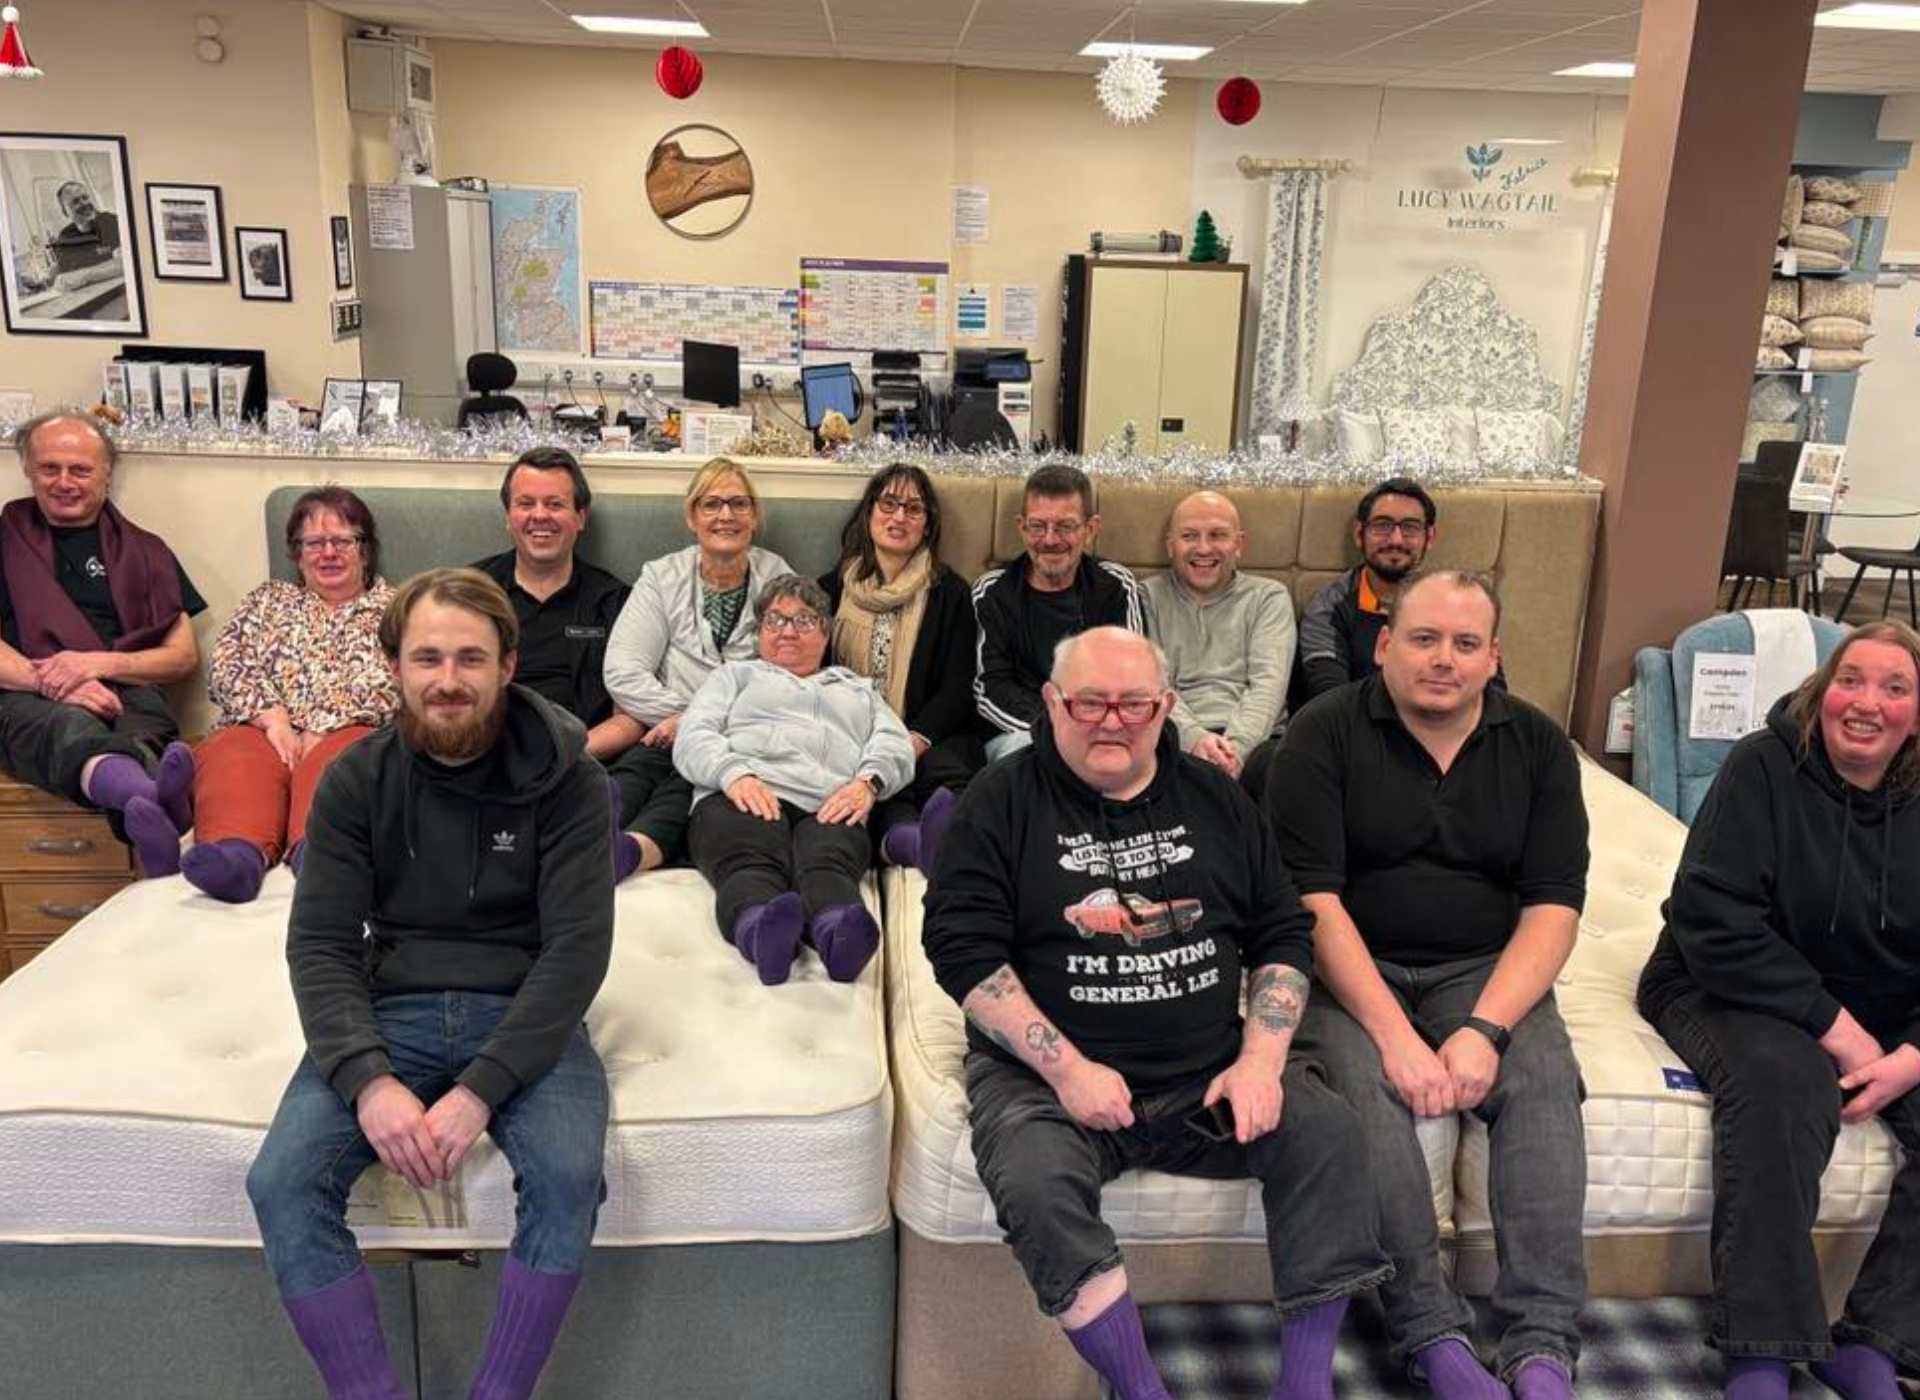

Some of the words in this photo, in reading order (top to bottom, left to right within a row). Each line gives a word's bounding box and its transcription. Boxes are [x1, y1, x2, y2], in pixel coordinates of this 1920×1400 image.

[1398, 189, 1450, 208] LUCY
[1460, 191, 1559, 212] WAGTAIL
[1129, 850, 1146, 863] TO
[1066, 954, 1110, 975] I'M
[1116, 938, 1216, 974] DRIVING
[1069, 981, 1183, 1004] GENERAL
[1187, 967, 1219, 993] LEE
[1140, 973, 1163, 985] THE
